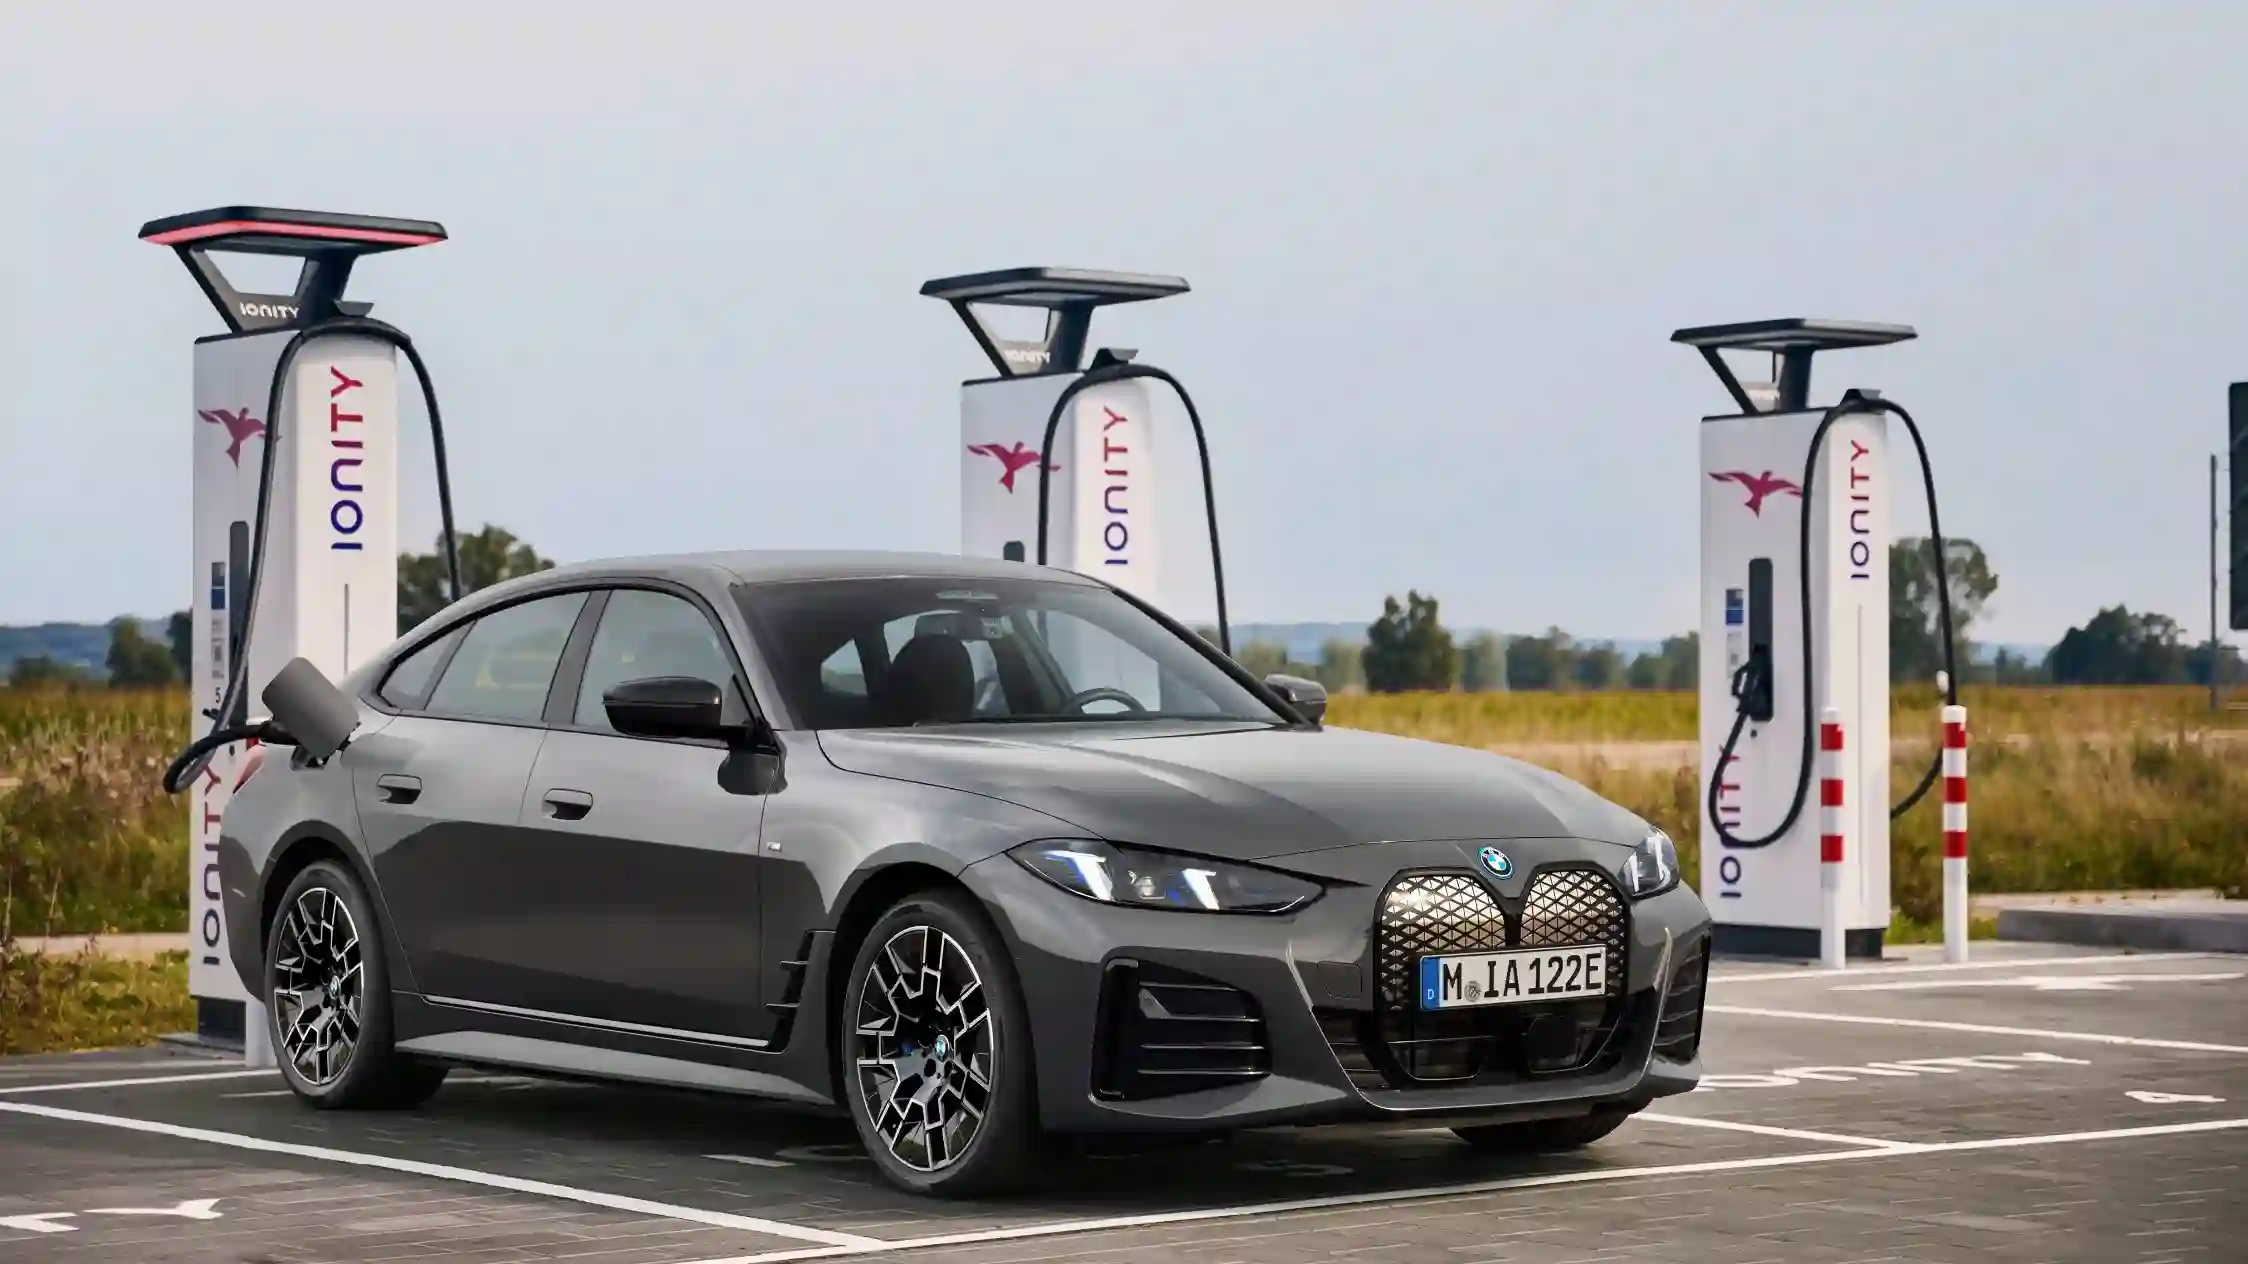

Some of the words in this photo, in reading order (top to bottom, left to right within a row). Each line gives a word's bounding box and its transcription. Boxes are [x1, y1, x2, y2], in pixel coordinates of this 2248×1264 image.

[330, 365, 364, 551] IONITY
[1103, 405, 1128, 565] IONITY
[1850, 439, 1870, 580] IONITY
[1527, 952, 1603, 996] 122E
